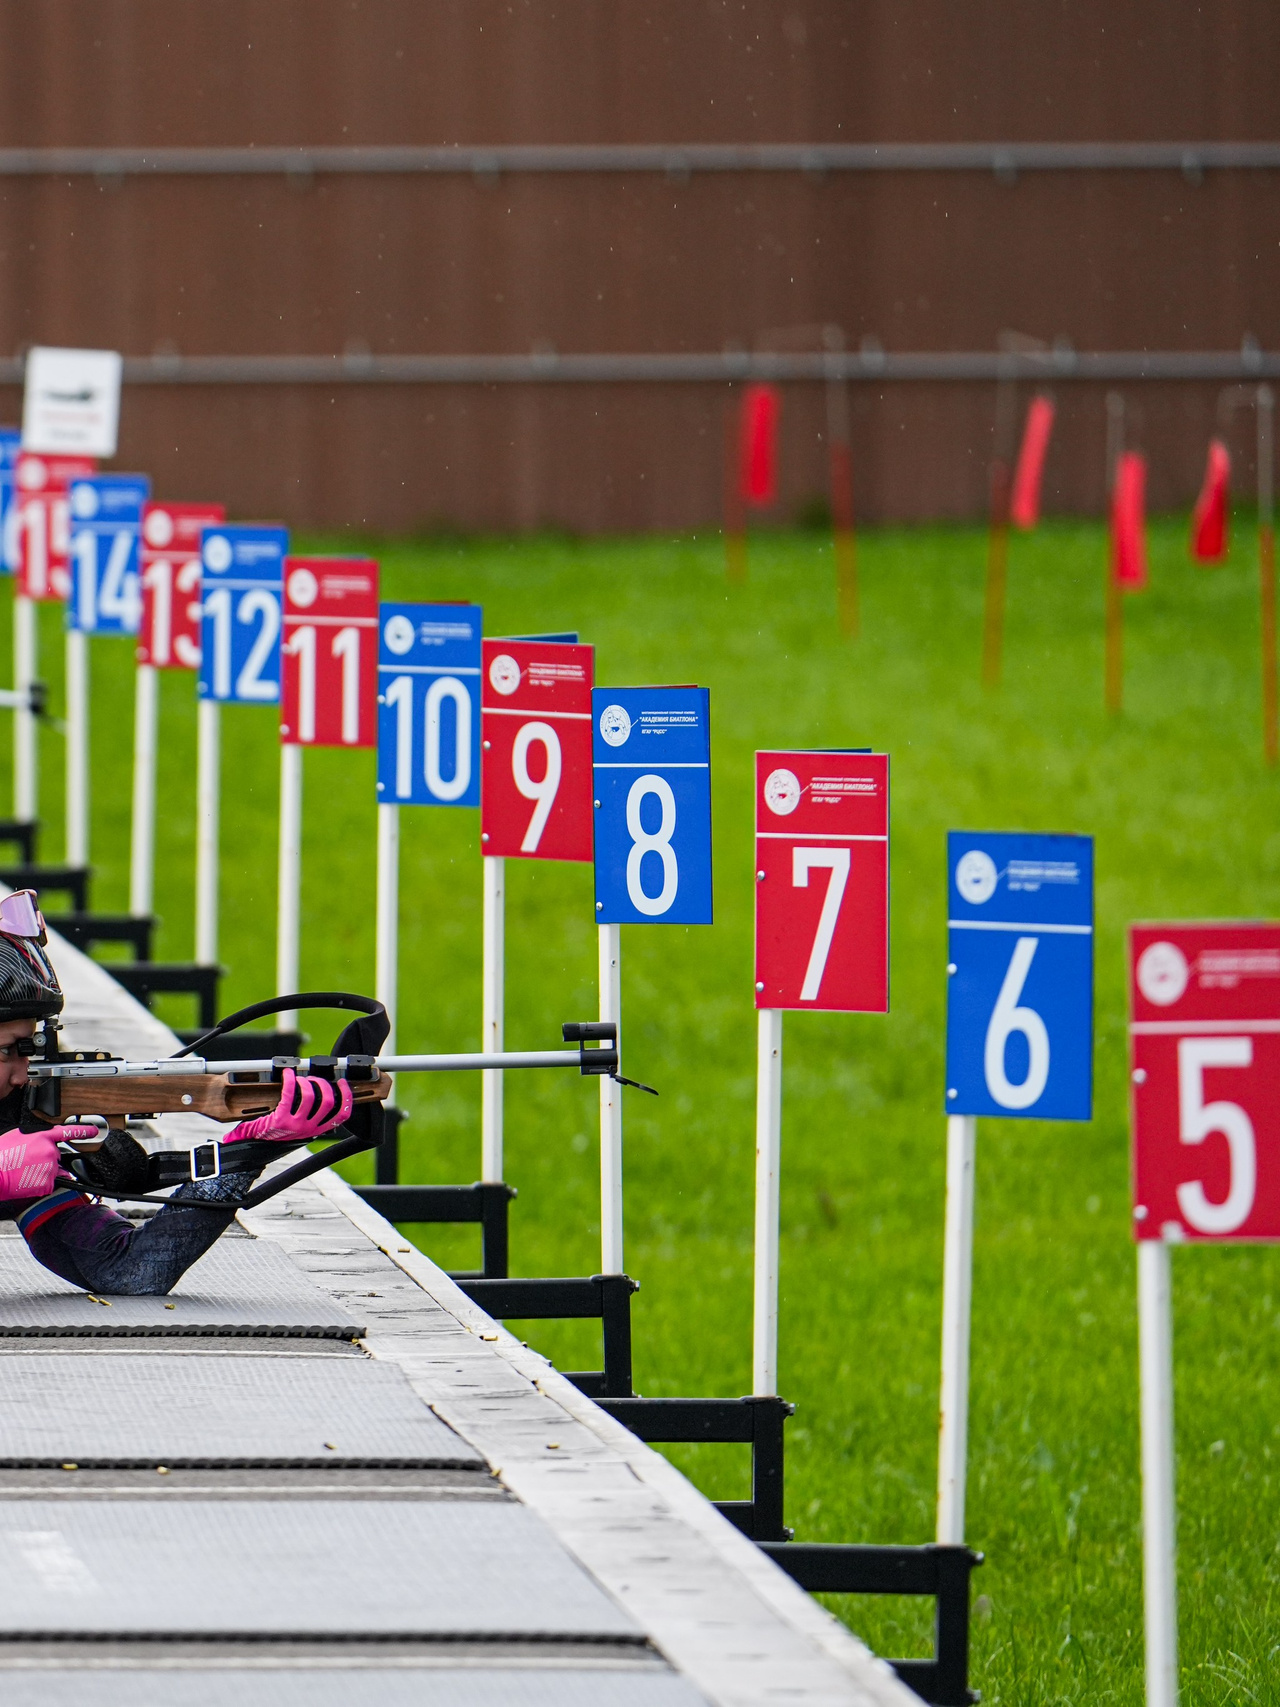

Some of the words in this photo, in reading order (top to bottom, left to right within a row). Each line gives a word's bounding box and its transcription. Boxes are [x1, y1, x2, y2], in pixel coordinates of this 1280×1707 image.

[72, 528, 142, 632] 14
[204, 588, 281, 699] 12
[289, 624, 360, 744] 11
[385, 676, 472, 801] 10
[512, 721, 562, 853] 9
[626, 774, 678, 916] 8
[792, 847, 851, 1000] 7
[984, 937, 1050, 1110] 6
[1176, 1036, 1257, 1234] 5
